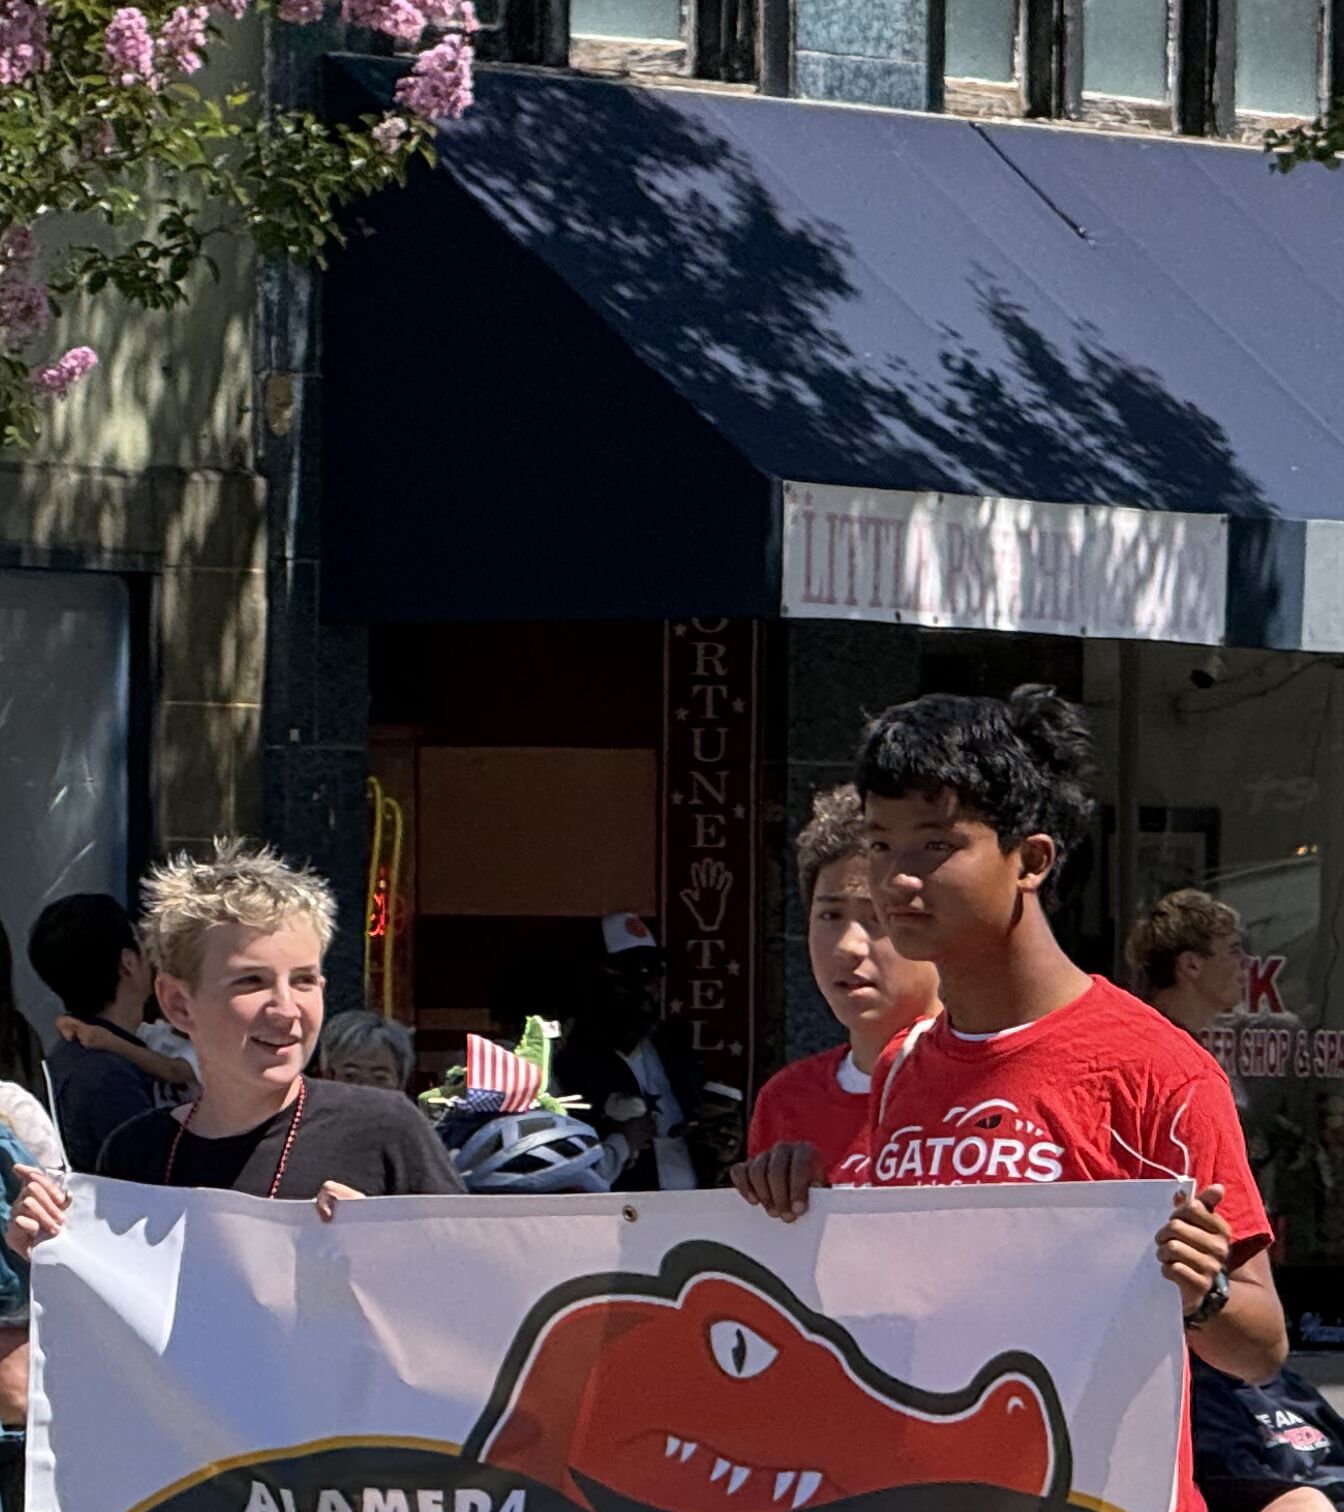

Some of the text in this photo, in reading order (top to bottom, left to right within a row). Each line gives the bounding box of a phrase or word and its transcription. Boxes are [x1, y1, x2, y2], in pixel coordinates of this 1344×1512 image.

[1241, 1027, 1291, 1077] SHOP
[1293, 1028, 1311, 1078] &
[876, 1136, 1065, 1182] GATORS
